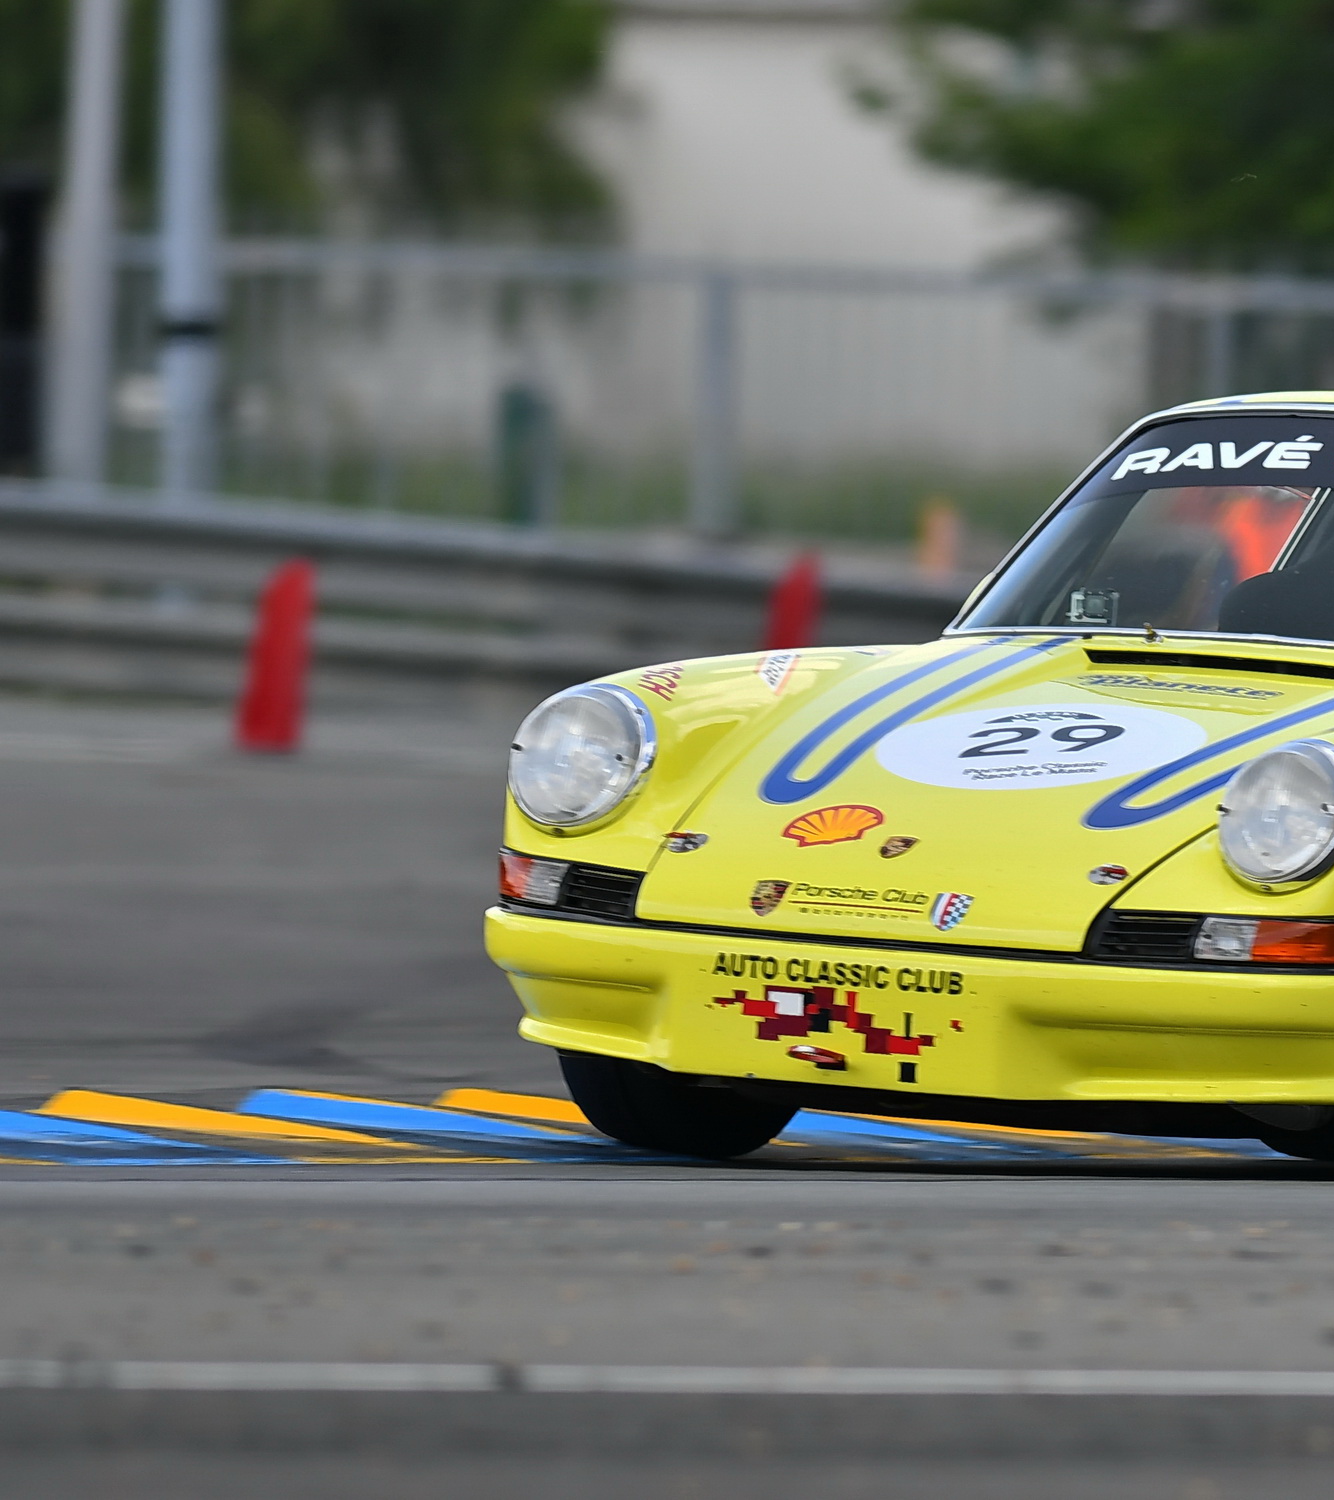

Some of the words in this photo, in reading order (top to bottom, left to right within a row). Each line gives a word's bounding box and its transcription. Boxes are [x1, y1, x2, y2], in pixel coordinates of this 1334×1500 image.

[1110, 435, 1324, 481] RAVÉ
[958, 725, 1126, 758] 29
[793, 883, 878, 901] Porsche
[882, 889, 930, 905] Club
[712, 952, 778, 980] AUTO
[785, 958, 890, 989] CLASSIC
[896, 967, 964, 995] CLUB
